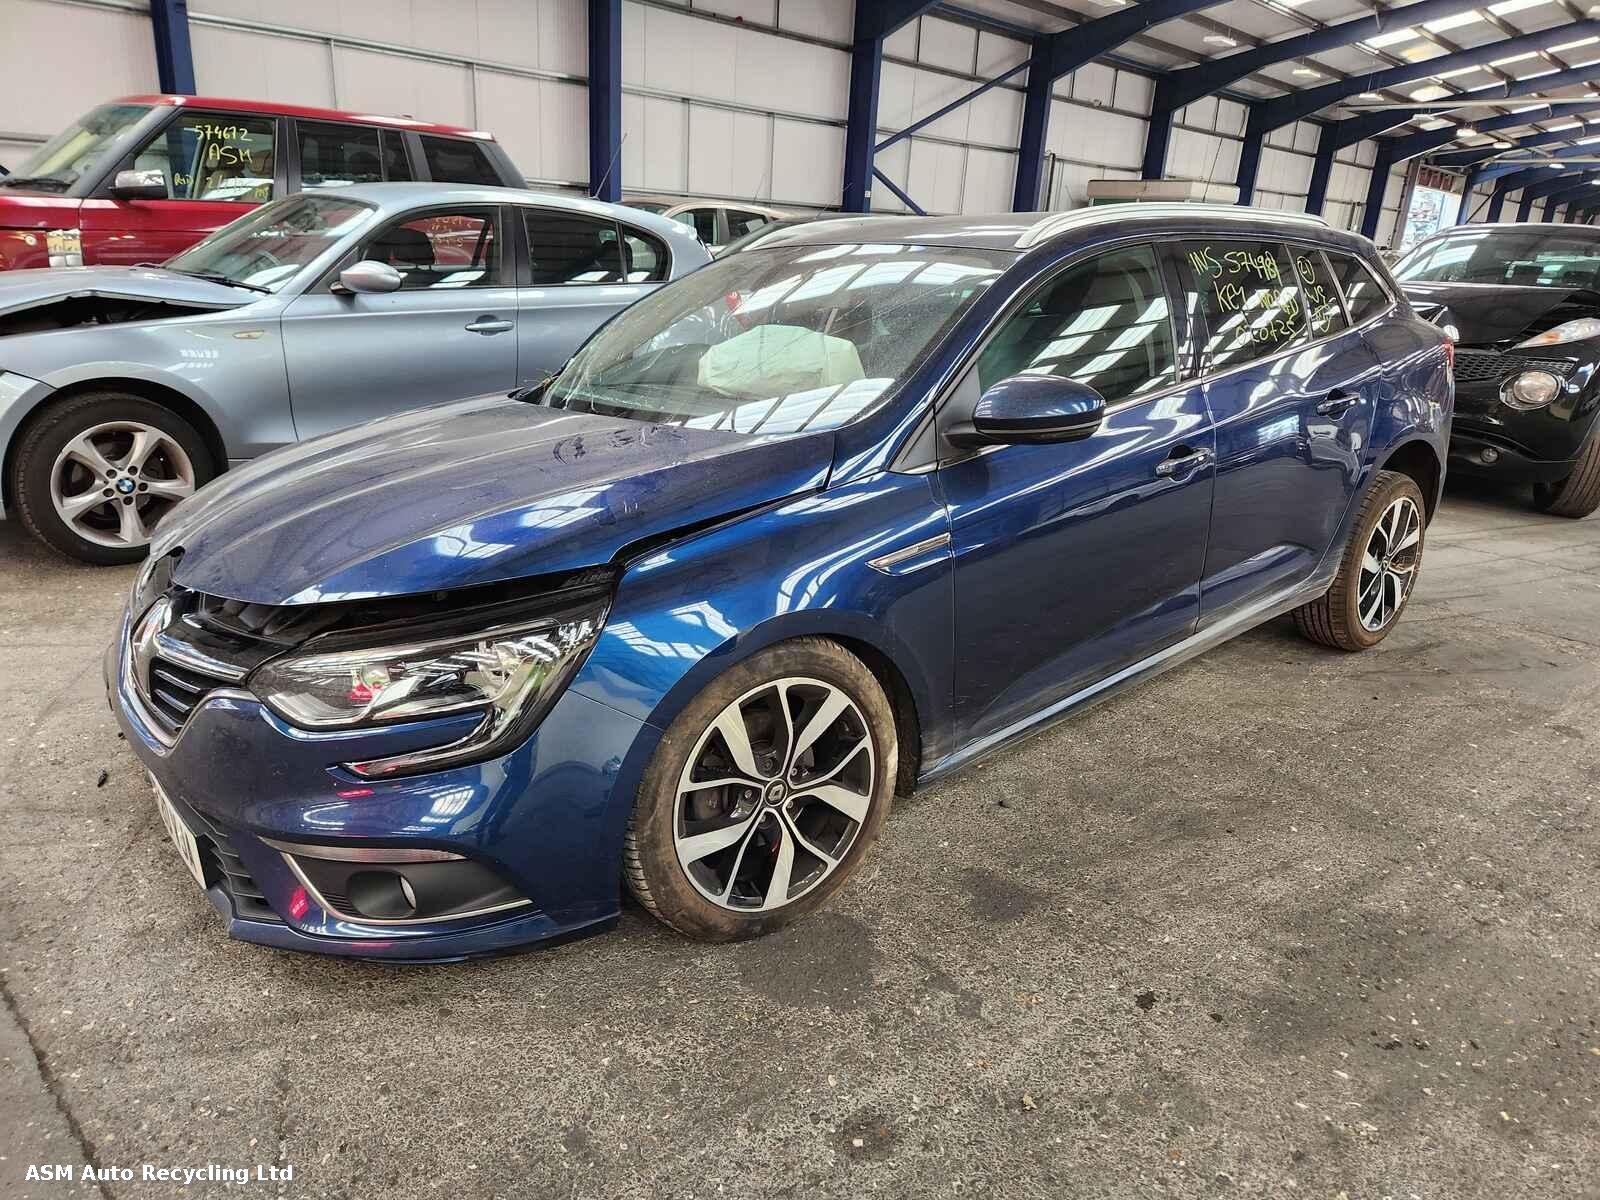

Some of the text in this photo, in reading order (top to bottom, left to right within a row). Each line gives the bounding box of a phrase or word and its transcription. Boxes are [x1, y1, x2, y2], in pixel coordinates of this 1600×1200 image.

[194, 125, 253, 141] 574672
[208, 142, 252, 165] ASM
[1189, 246, 1223, 279] INS
[1213, 280, 1247, 313] KEY
